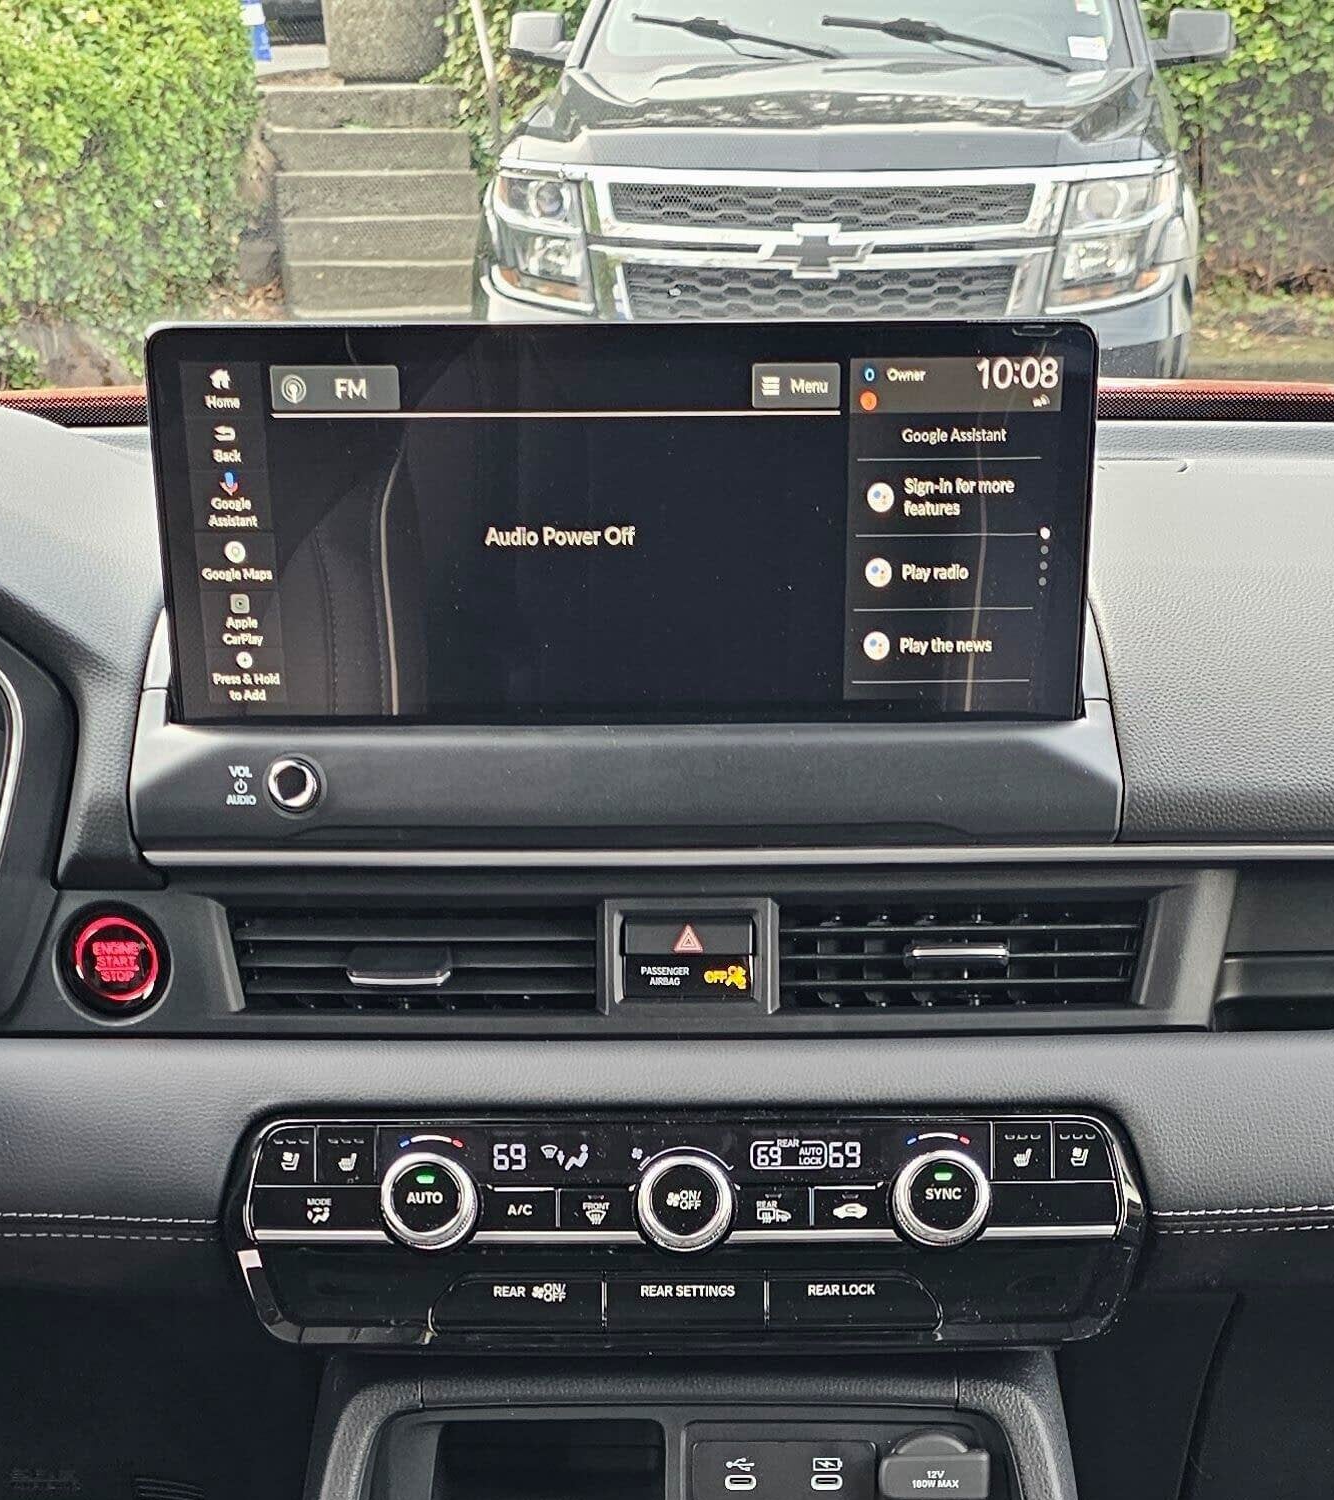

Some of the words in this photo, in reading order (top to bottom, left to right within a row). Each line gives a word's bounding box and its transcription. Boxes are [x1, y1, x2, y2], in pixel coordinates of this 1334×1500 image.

[886, 368, 926, 383] Owner
[976, 356, 1059, 389] 10:08
[334, 378, 367, 400] FM
[790, 377, 828, 394] Menu
[204, 395, 241, 409] Home
[901, 427, 948, 445] Google
[950, 427, 1007, 443] Assistant
[213, 449, 242, 463] Back
[903, 477, 953, 496] Sign-in
[955, 477, 977, 494] for
[978, 479, 1015, 494] more
[211, 497, 251, 512] Google
[903, 500, 960, 517] features
[208, 514, 258, 527] Assistant
[485, 526, 539, 546] Audio
[542, 527, 601, 546] Power
[604, 525, 636, 546] Off
[202, 567, 241, 582] Google
[243, 567, 273, 582] Maps
[901, 563, 931, 582] Play
[933, 563, 969, 580] radio
[225, 617, 258, 631] Apple
[222, 633, 264, 646] CarPlay
[899, 637, 928, 655] Play
[931, 636, 954, 653] the
[956, 639, 993, 652] news
[212, 672, 241, 686] Press
[254, 672, 280, 685] Hold
[229, 688, 242, 701] to
[244, 688, 266, 701] Add
[228, 765, 253, 778] VOL
[226, 794, 257, 806] AUDIO
[96, 955, 137, 967] START
[640, 966, 689, 976] PASSENGER
[649, 976, 681, 986] AIRBAG
[777, 1138, 799, 1148] REAR
[493, 1143, 526, 1170] 69
[757, 1146, 781, 1166] 69
[829, 1142, 861, 1168] 69
[799, 1147, 822, 1156] AUTO
[799, 1156, 822, 1165] LOCK
[406, 1191, 443, 1204] AUTO
[925, 1187, 962, 1200] SYNC
[307, 1198, 332, 1206] MODE
[582, 1202, 611, 1210] FRONT
[679, 1200, 701, 1210] OFF
[507, 1204, 532, 1216] A/C
[493, 1286, 526, 1297] REAR
[640, 1285, 673, 1297] REAR
[675, 1285, 736, 1297] SETTINGS
[808, 1284, 840, 1296] REAR
[842, 1284, 875, 1296] LOCK
[543, 1292, 566, 1302] OFF
[927, 1470, 945, 1479] 12V
[937, 1480, 959, 1488] MAX
